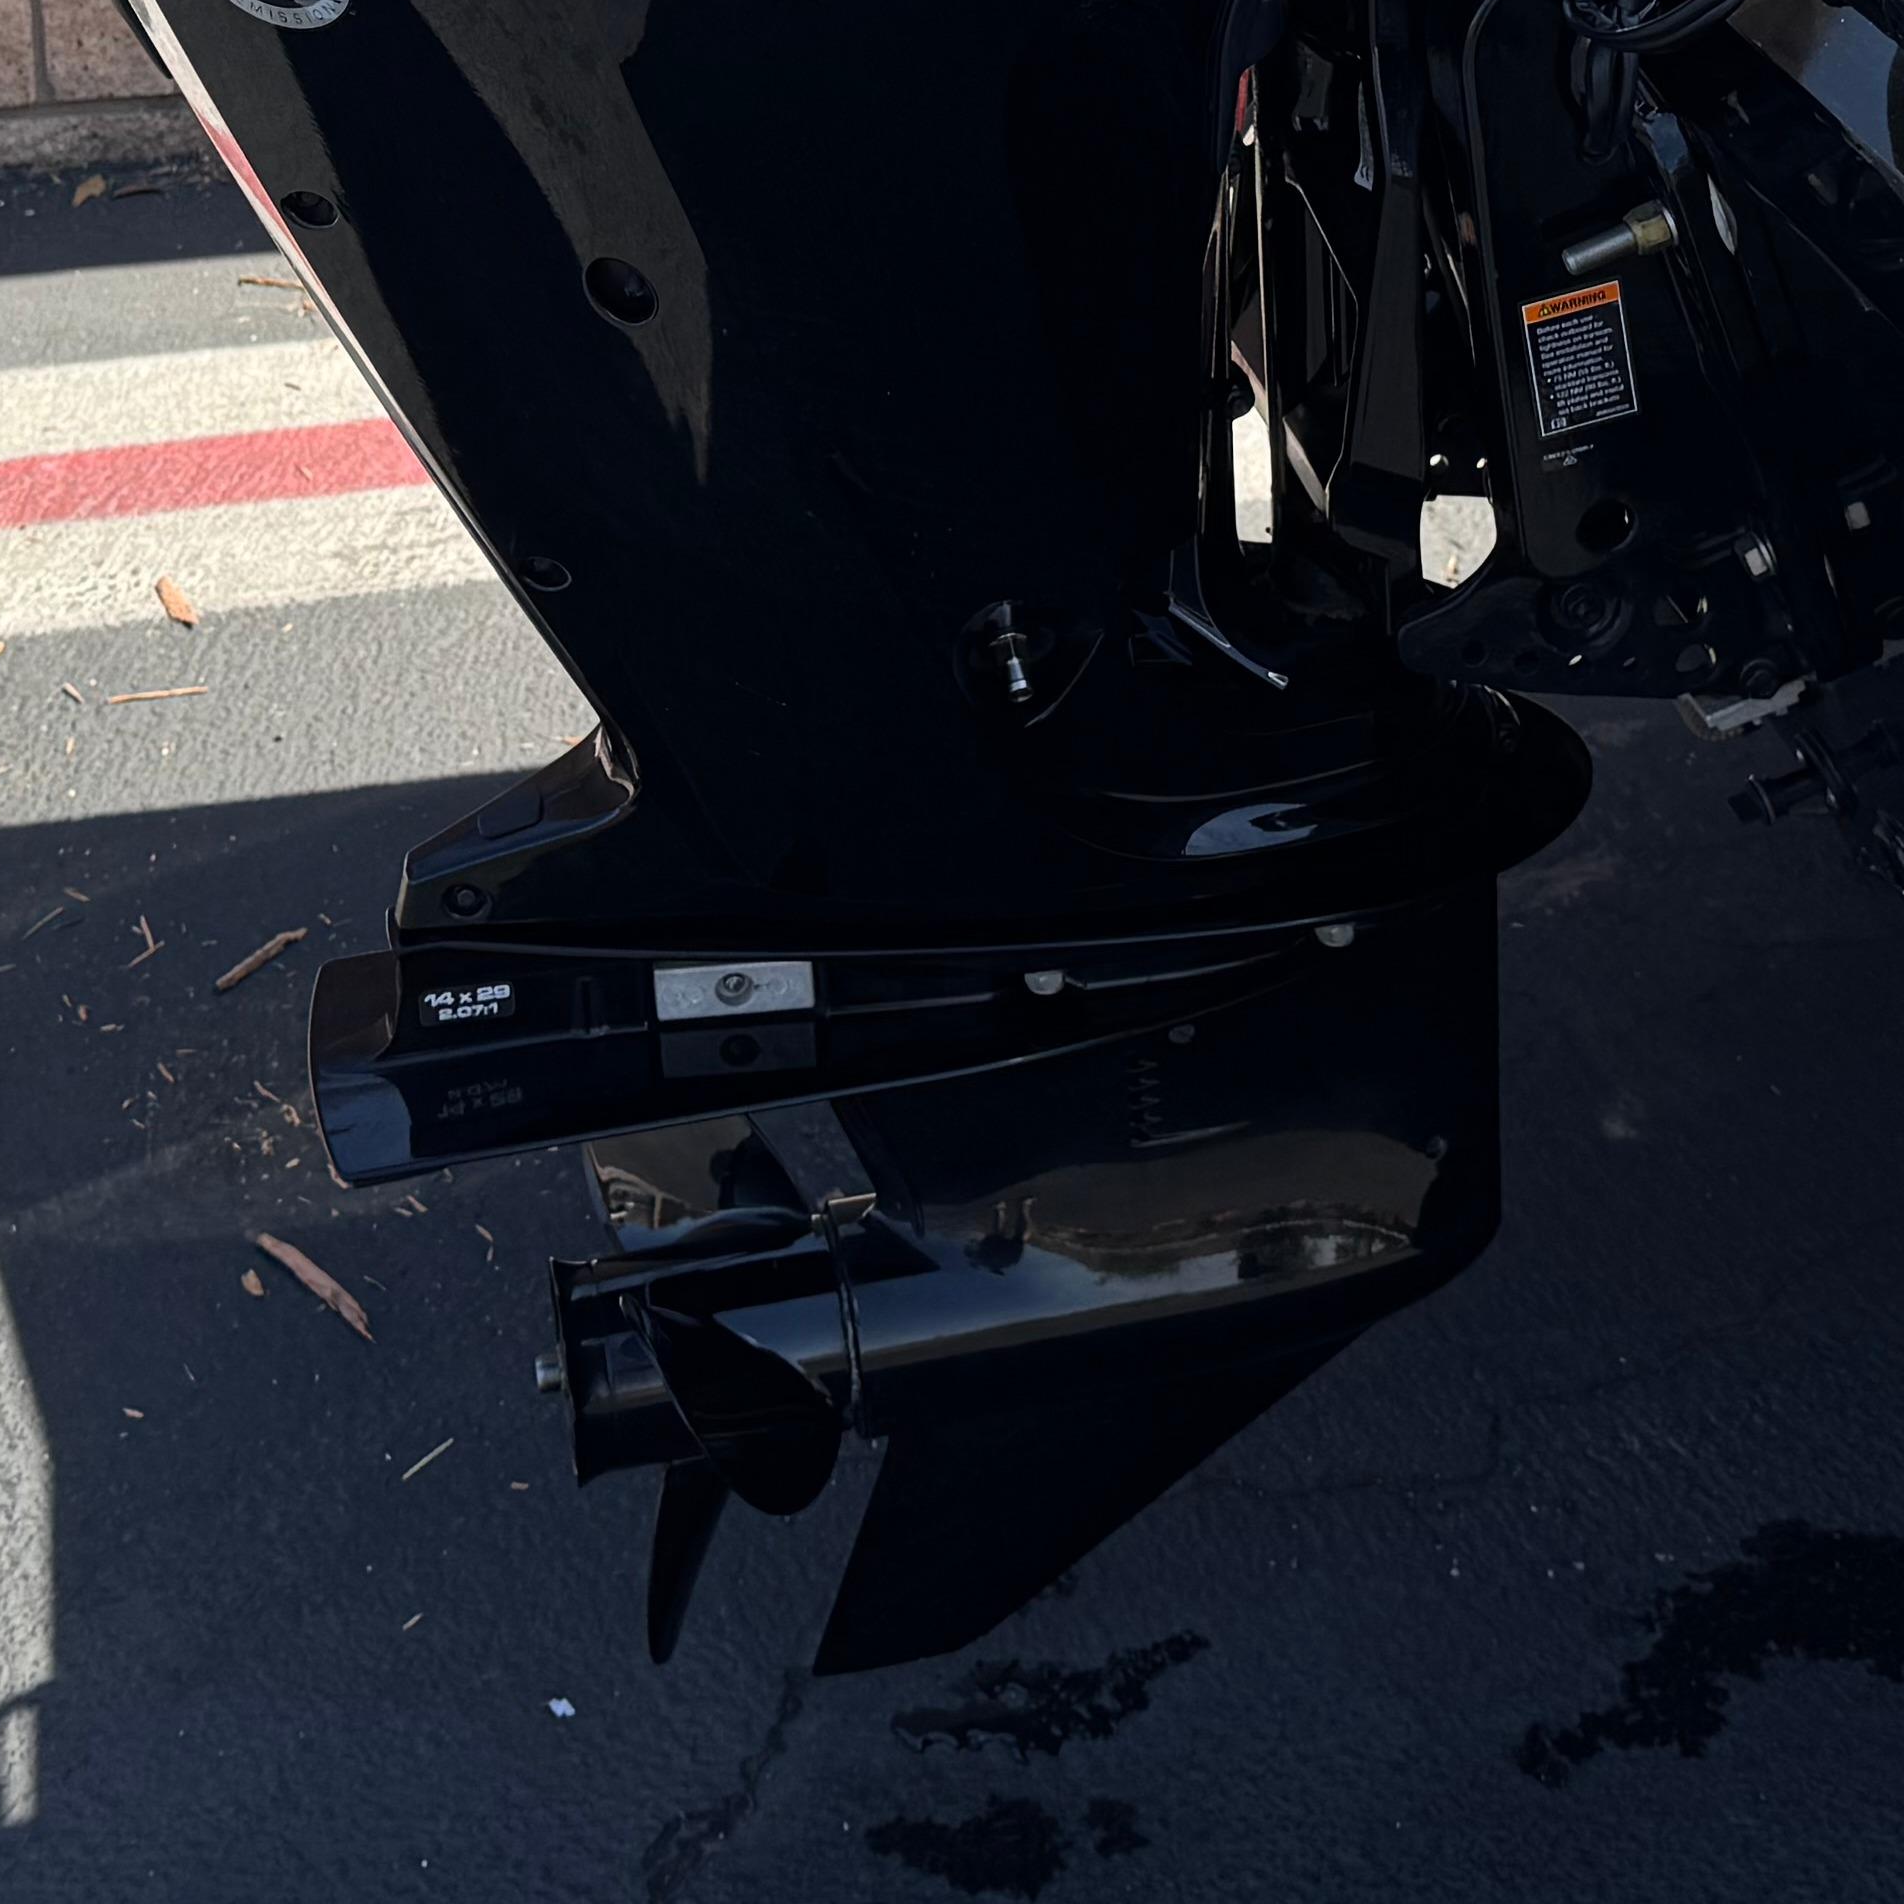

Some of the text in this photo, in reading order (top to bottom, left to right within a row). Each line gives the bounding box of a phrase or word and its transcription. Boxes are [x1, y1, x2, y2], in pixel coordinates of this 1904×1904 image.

[1550, 290, 1607, 313] WARNING
[423, 991, 455, 1008] 14
[459, 992, 473, 1004] x
[438, 1002, 498, 1021] 2.07:1
